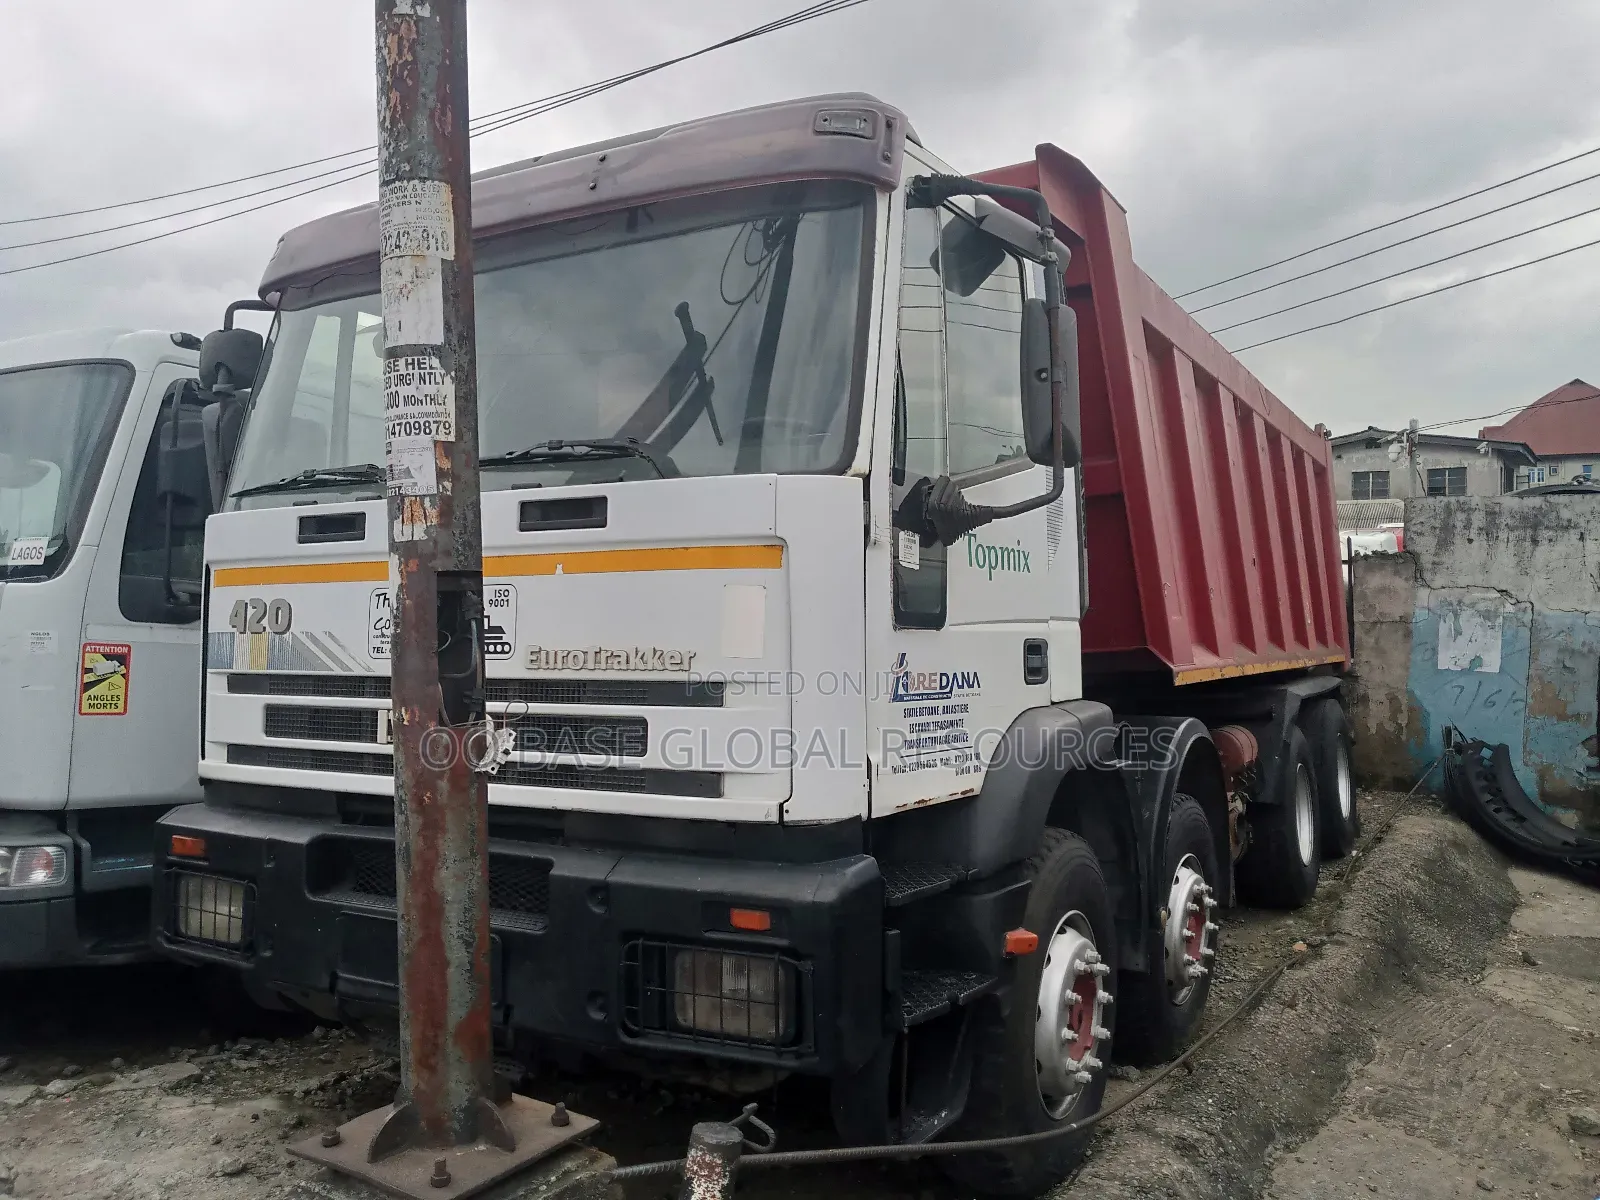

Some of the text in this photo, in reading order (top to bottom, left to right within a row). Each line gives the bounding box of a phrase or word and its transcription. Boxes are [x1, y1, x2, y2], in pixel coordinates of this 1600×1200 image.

[405, 357, 438, 371] HEL
[403, 394, 448, 407] MONTHLY
[12, 547, 43, 561] LAGOS
[963, 533, 1031, 581] Topmix
[494, 589, 510, 598] ISO
[488, 598, 510, 608] 9001
[229, 598, 293, 635] 420
[85, 645, 129, 653] ATTENTION
[372, 646, 387, 654] TEL:
[525, 645, 697, 671] EuroTrakker
[87, 694, 121, 702] ANGLES
[88, 702, 119, 710] MORTS
